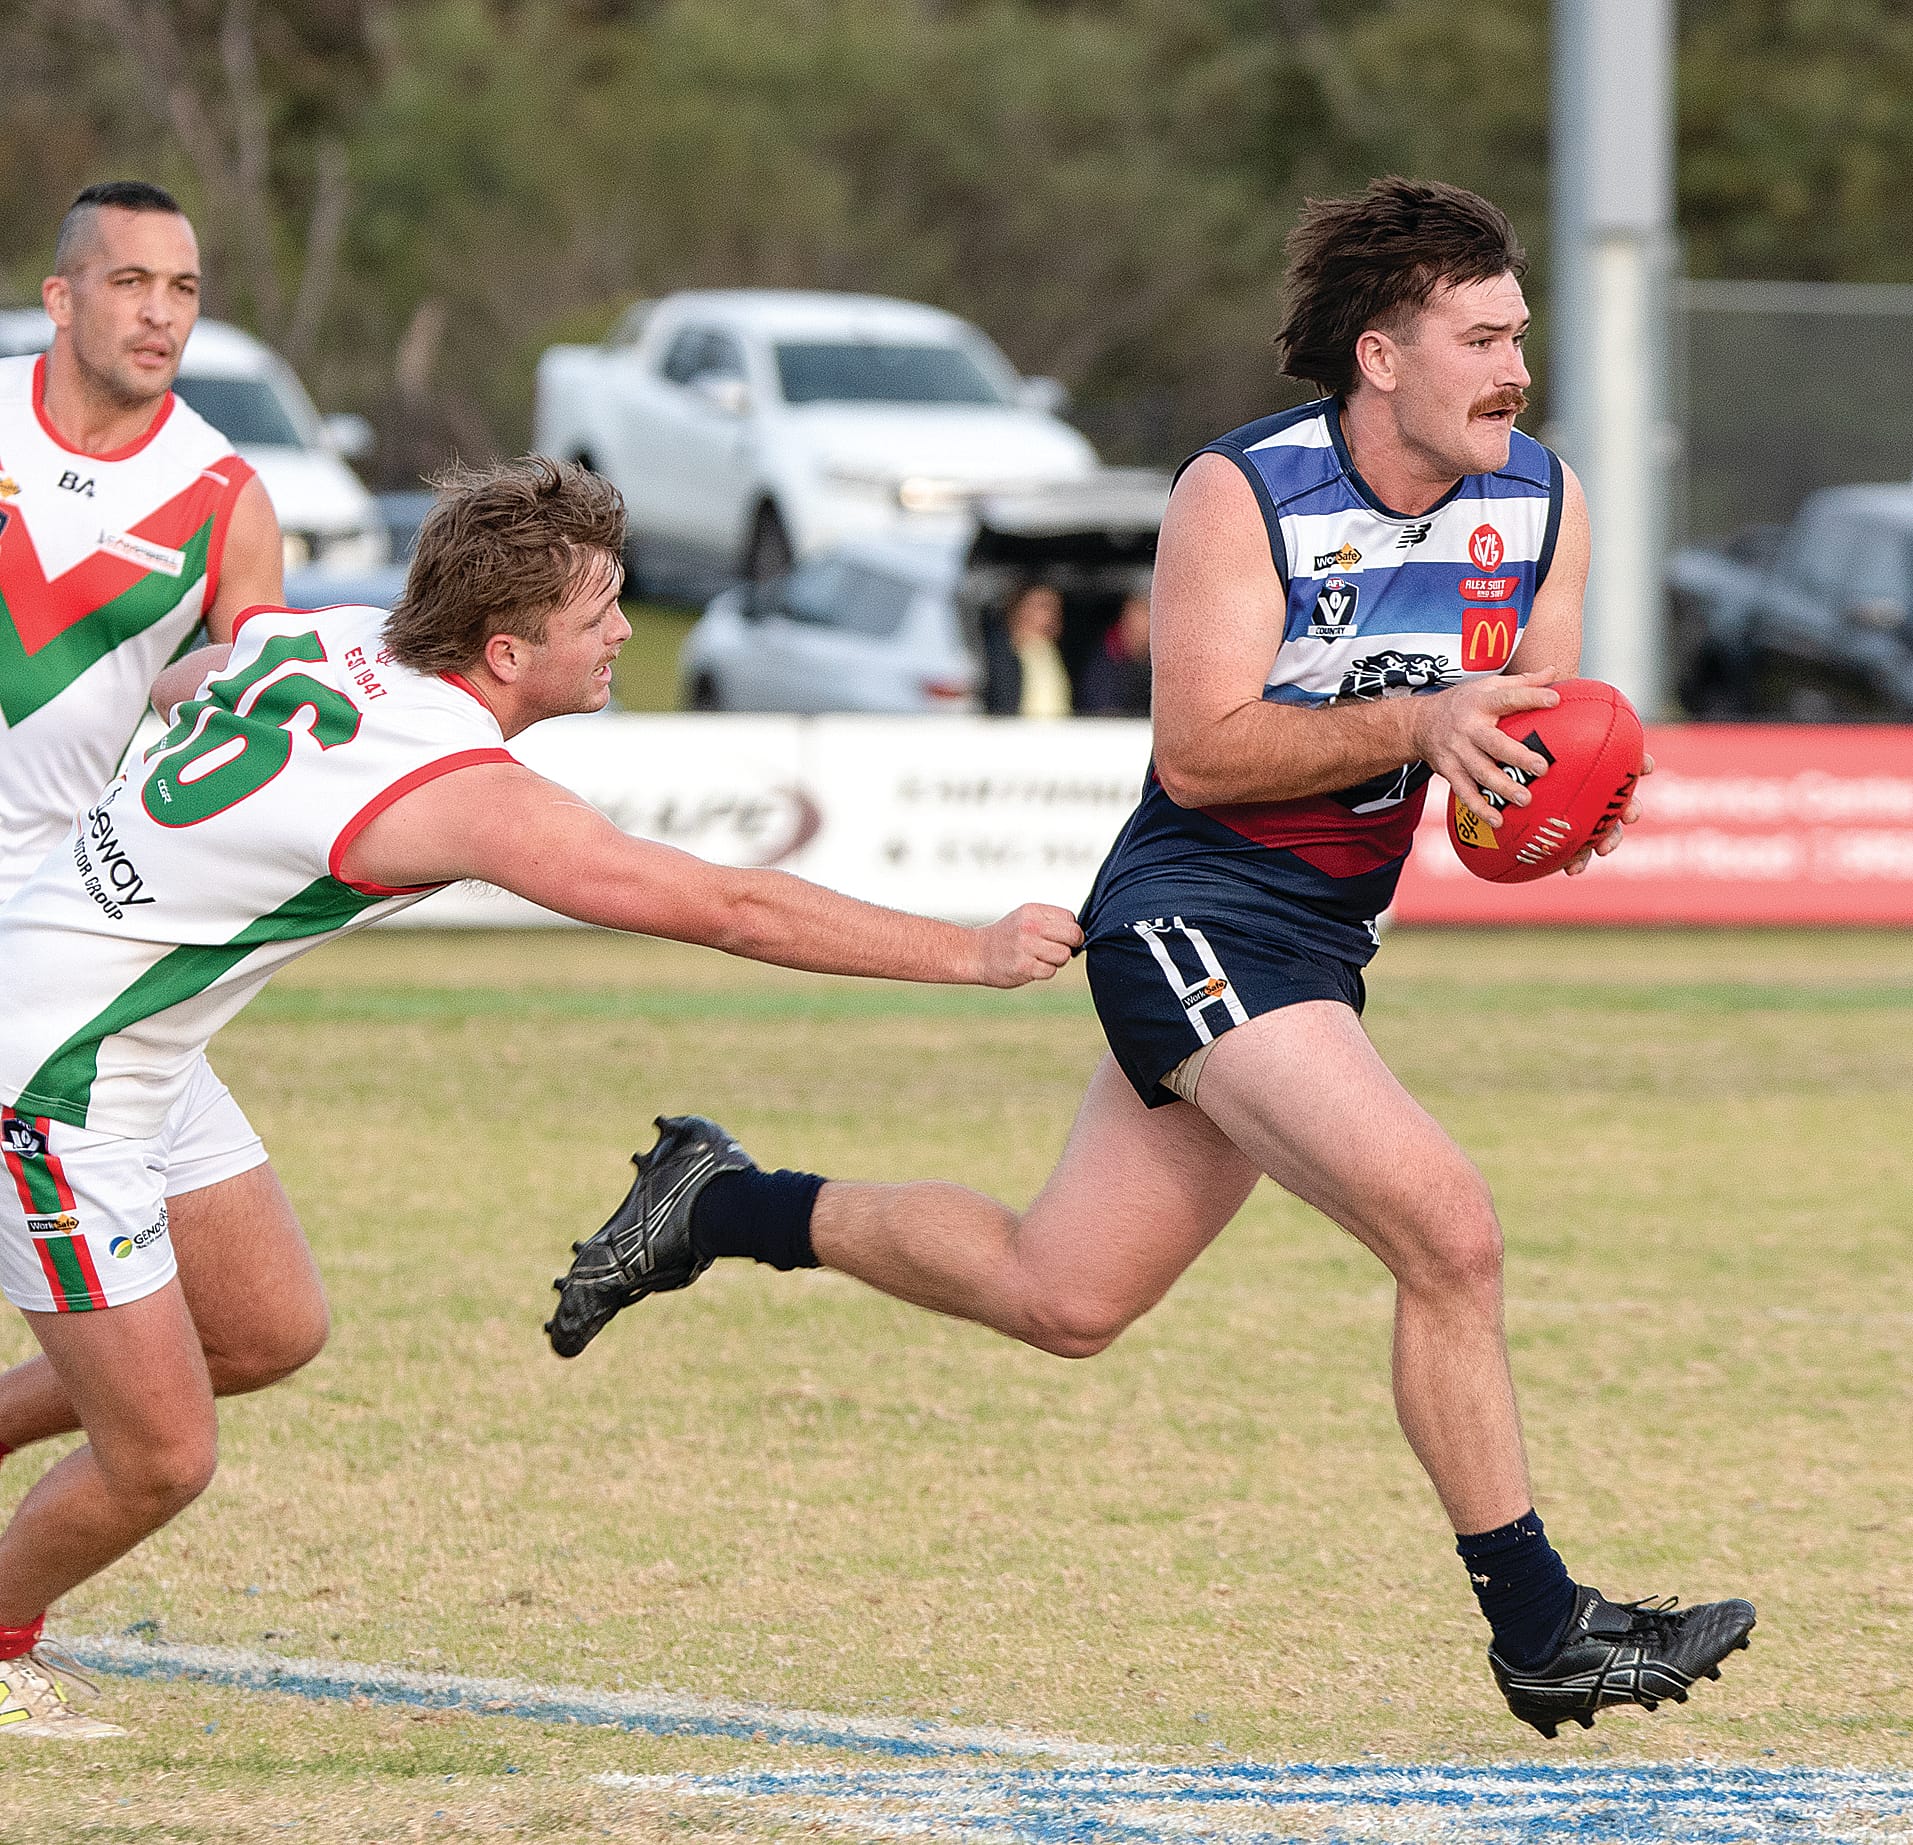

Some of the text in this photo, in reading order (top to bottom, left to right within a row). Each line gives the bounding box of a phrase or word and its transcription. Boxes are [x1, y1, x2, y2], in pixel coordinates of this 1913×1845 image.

[1465, 580, 1487, 590] ALEX
[344, 646, 366, 671] EST
[354, 668, 387, 700] 1947
[84, 875, 124, 920] GROUP
[1184, 981, 1224, 1006] WorkSafe
[30, 1219, 76, 1230] WorkSafe
